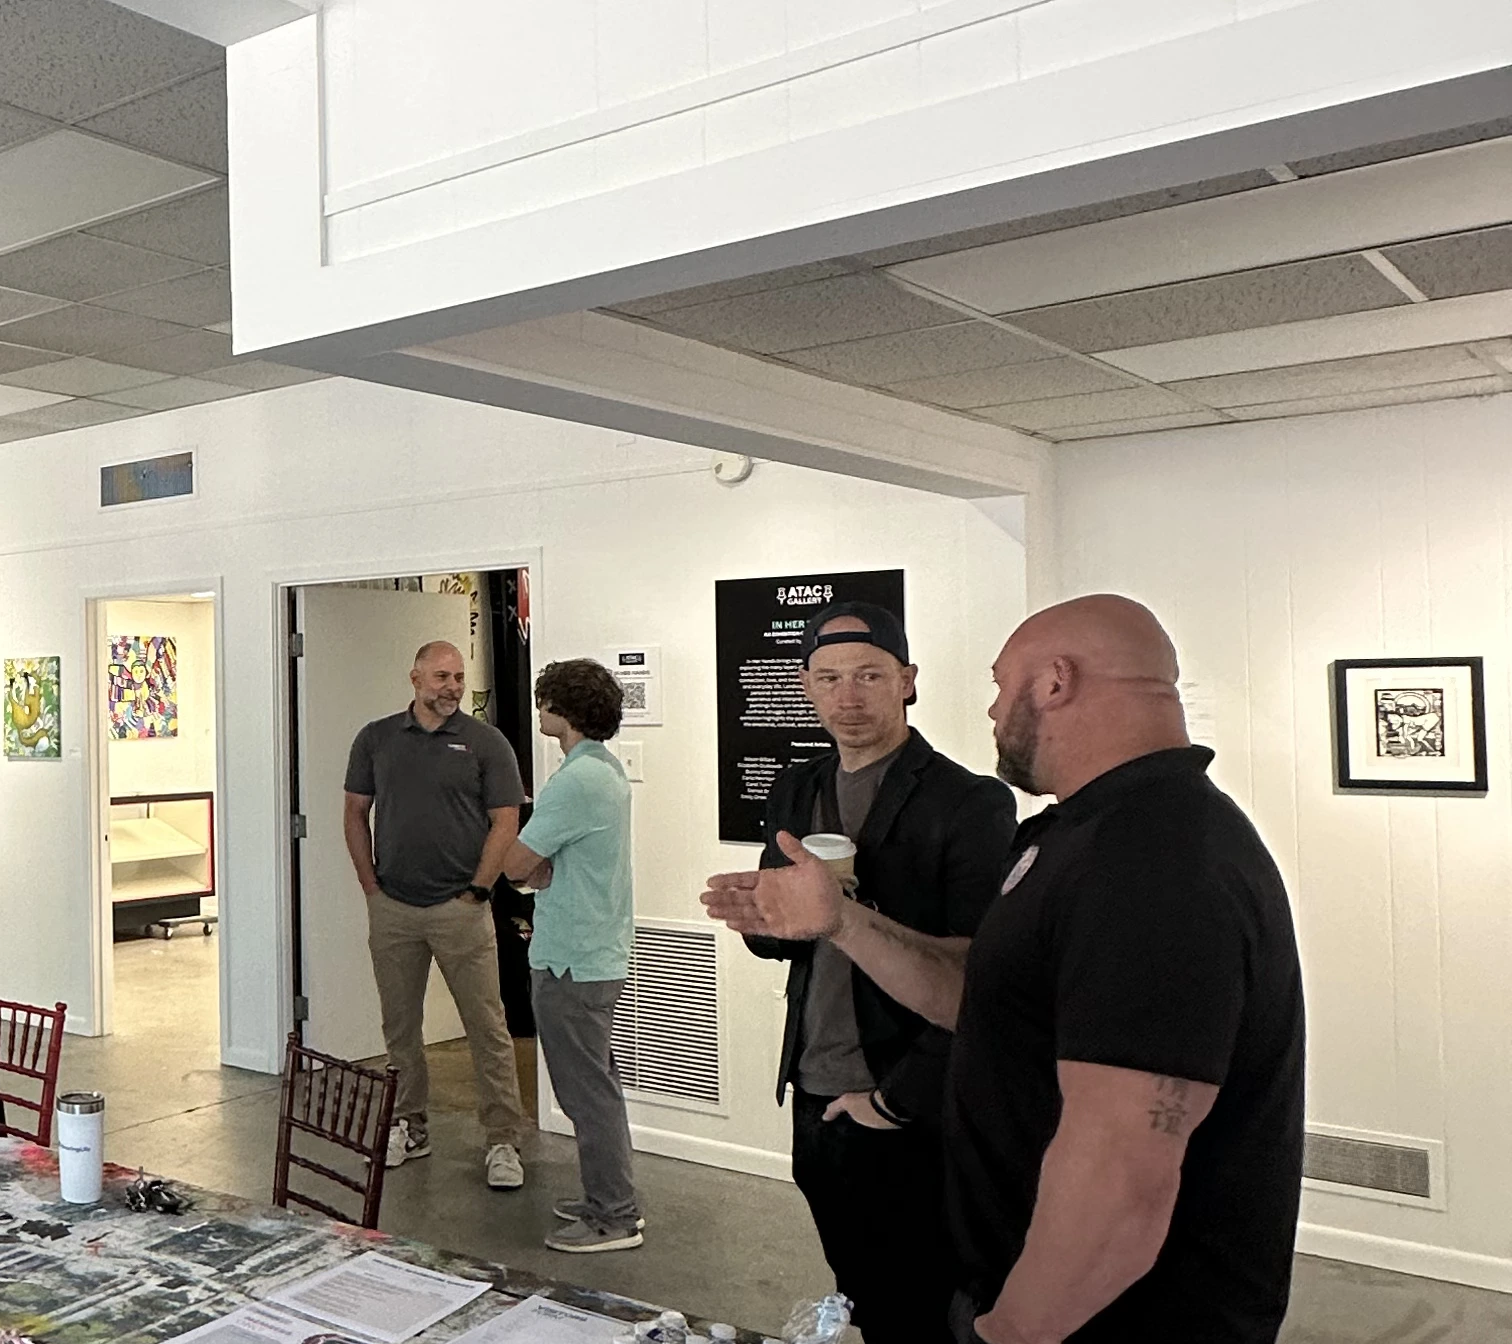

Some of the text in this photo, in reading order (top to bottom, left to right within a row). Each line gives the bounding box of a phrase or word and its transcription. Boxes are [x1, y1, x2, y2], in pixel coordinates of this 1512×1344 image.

[788, 585, 822, 597] ATAC
[787, 597, 822, 605] GALLERY
[771, 619, 805, 629] IN HER
